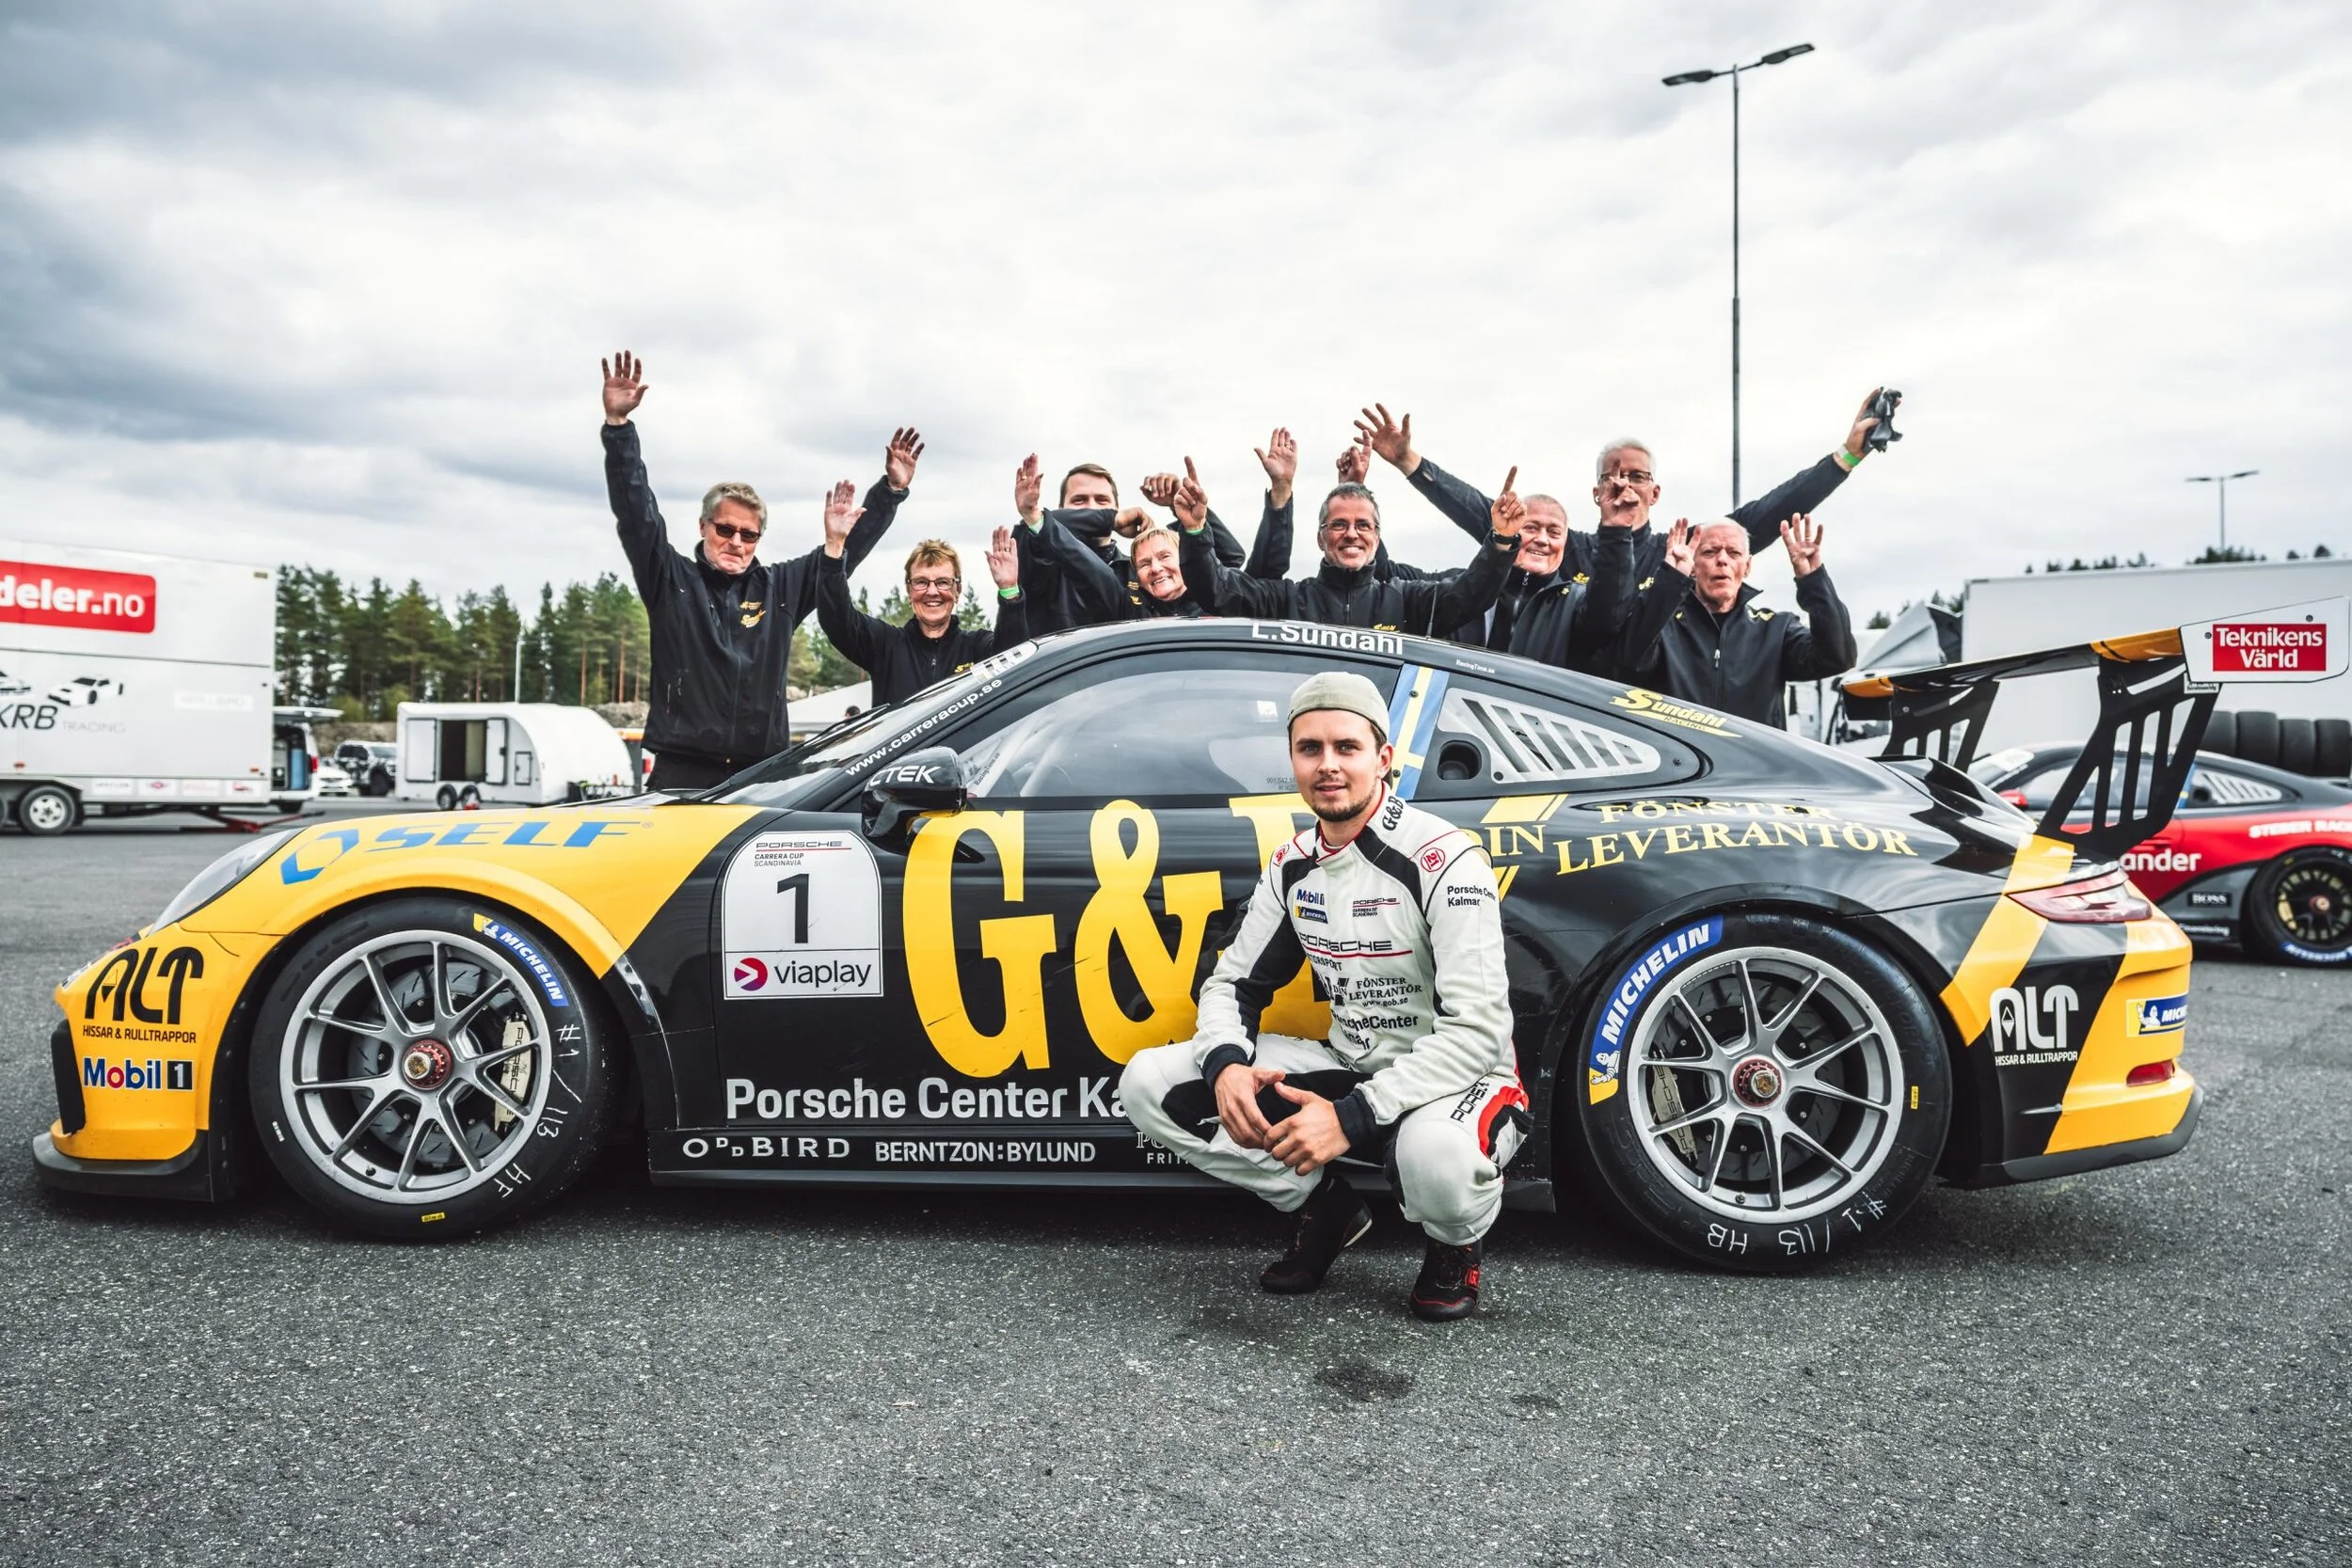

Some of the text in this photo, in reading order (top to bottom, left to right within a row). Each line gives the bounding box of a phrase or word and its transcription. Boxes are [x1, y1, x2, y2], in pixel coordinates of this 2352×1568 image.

[1251, 623, 1403, 655] L.Sundahl
[2217, 627, 2323, 648] Teknikens
[2240, 648, 2298, 669] Värld
[1609, 689, 1727, 728] Sundahl
[846, 678, 1002, 776] www.carreracup.se
[1663, 717, 1708, 731] RACING
[870, 765, 942, 787] CTEK
[1382, 796, 1404, 831] G&B
[1598, 800, 1842, 823] FÖNSTER
[364, 821, 642, 852] SELF
[1553, 820, 1918, 876] LEVERANTÖR
[1447, 885, 1483, 895] Porsche
[1448, 896, 1481, 908] Kalmar
[777, 873, 809, 943] 1
[1299, 932, 1392, 952] PORSCHE
[500, 931, 564, 1000] MICHELIN
[773, 960, 871, 988] viaplay
[85, 946, 204, 1025] ALT
[1332, 984, 1347, 996] DIN
[1349, 984, 1422, 1001] LEVERANTÖR
[1356, 977, 1406, 989] FÖNSTER
[1601, 923, 1710, 1046] MICHELIN
[1362, 997, 1407, 1007] www.gob.se
[1989, 985, 2079, 1052] ALT
[83, 1025, 197, 1043] HISSAR & RULLTRAPPOR
[1995, 1051, 2078, 1066] HISSAR & RULLTRAPPOR
[84, 1058, 161, 1089] Mobil
[725, 1077, 906, 1119] Porsche
[914, 1076, 1067, 1119] Center
[1708, 1224, 1748, 1255] HB
